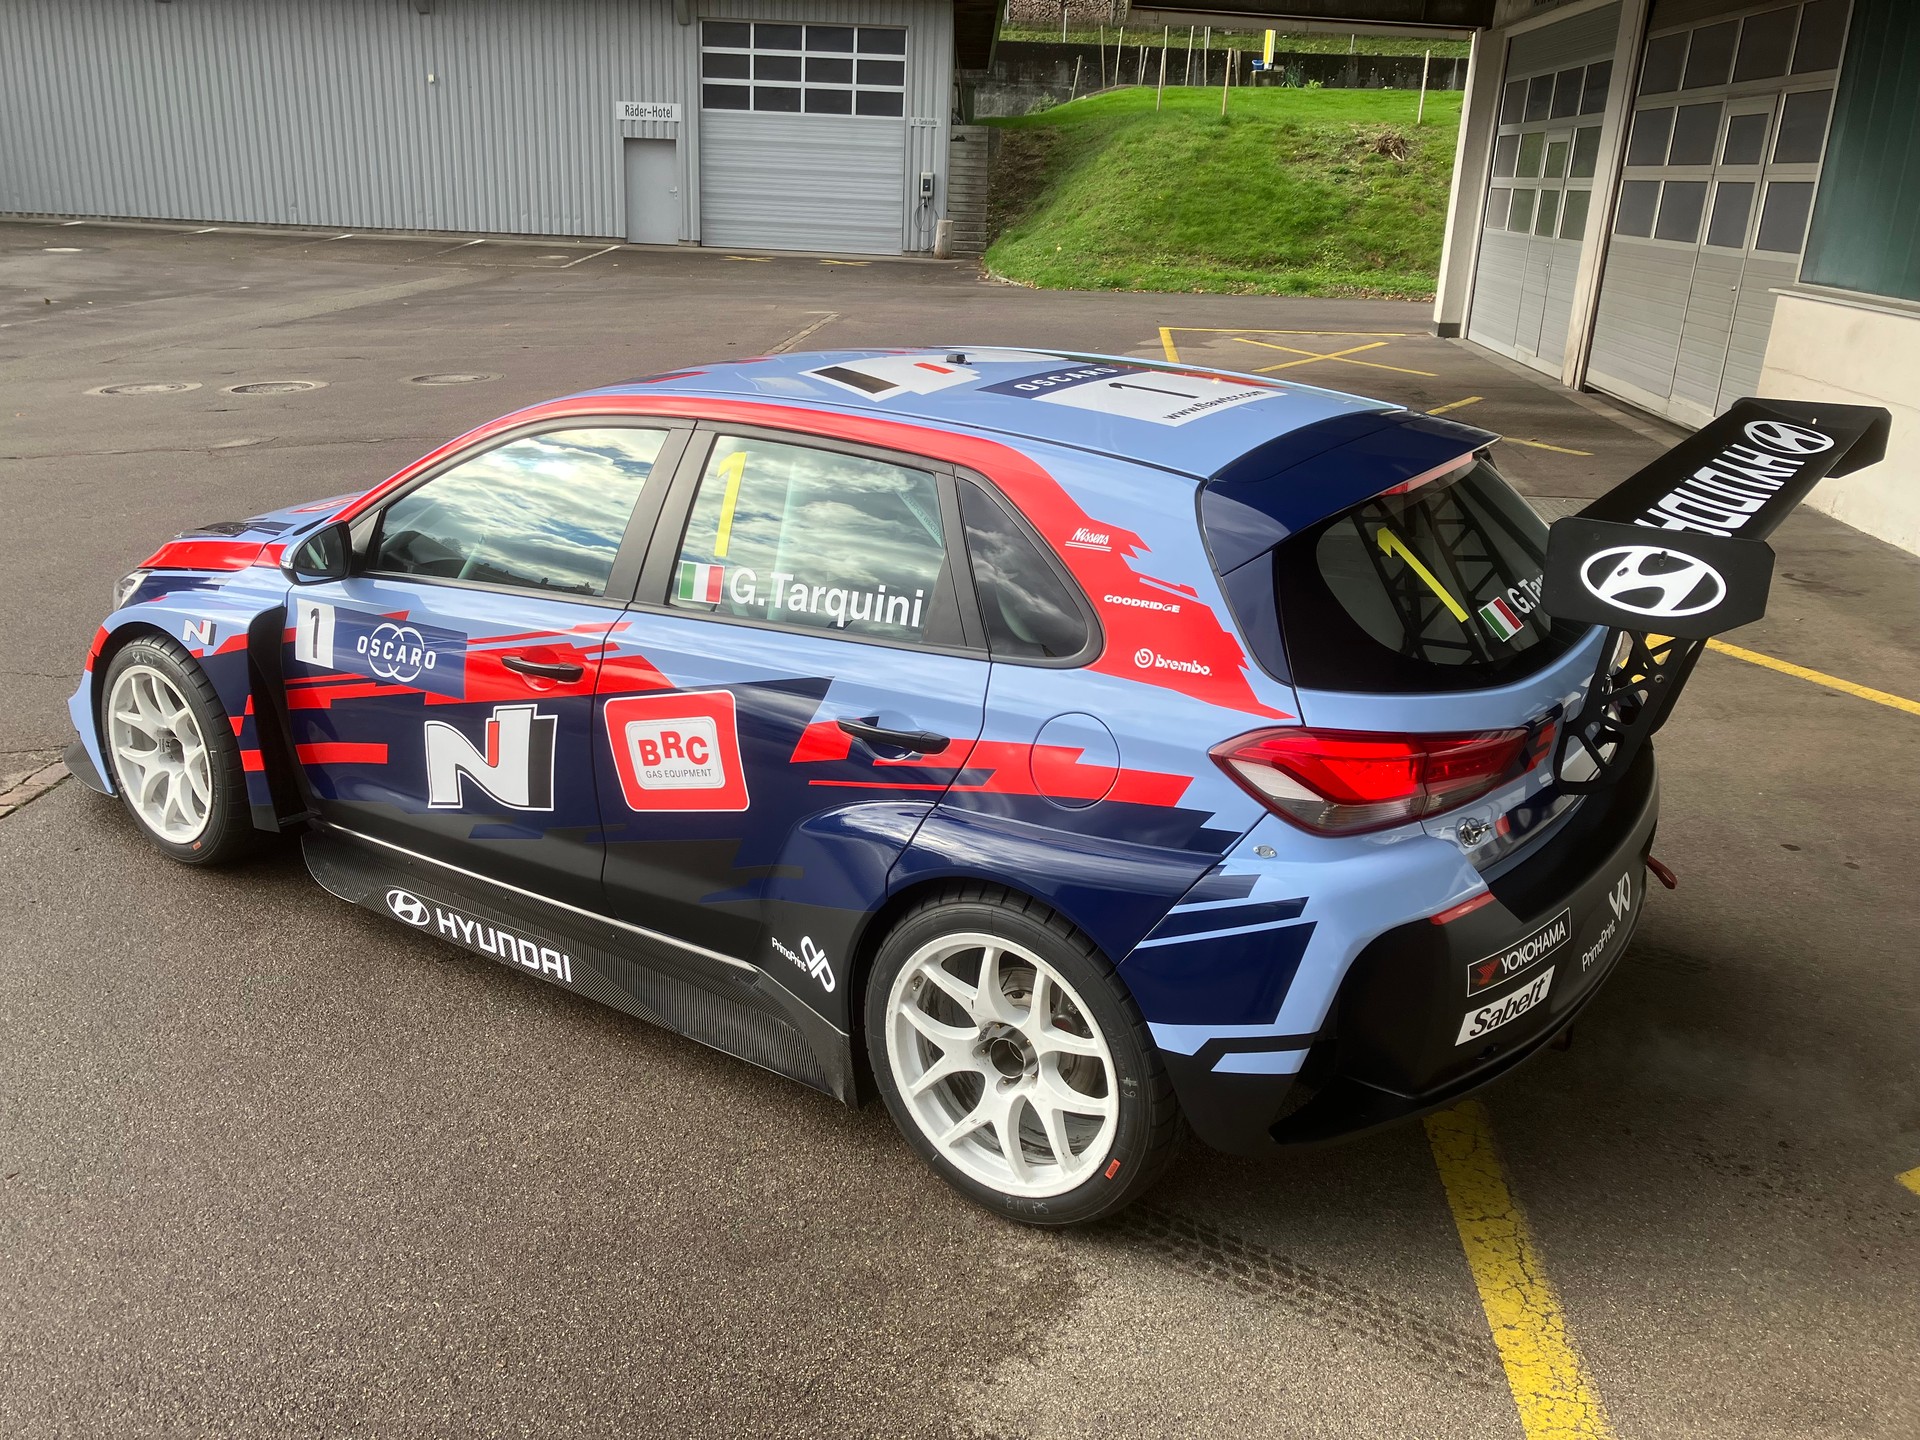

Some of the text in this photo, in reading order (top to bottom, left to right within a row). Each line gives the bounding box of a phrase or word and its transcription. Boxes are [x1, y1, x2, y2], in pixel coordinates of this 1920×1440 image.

[625, 104, 673, 118] Räder-Hotel
[1013, 367, 1119, 391] OSCARO
[1108, 382, 1200, 399] 1
[714, 451, 747, 557] 1
[1634, 444, 1805, 537] HYUNDA
[1072, 527, 1110, 546] Nissens
[1377, 527, 1469, 623] 1
[729, 567, 924, 628] G.Tarquini
[1103, 594, 1181, 613] GOODRIDGE
[310, 607, 320, 659] 1
[356, 635, 437, 670] OSCARO
[1155, 654, 1211, 676] brembo
[638, 731, 709, 766] BRC
[645, 768, 712, 779] GAS EQUIPMENT
[436, 908, 572, 983] HYUNDAI
[1500, 920, 1567, 975] YOKOHAMA
[1469, 977, 1546, 1037] Sabelt
